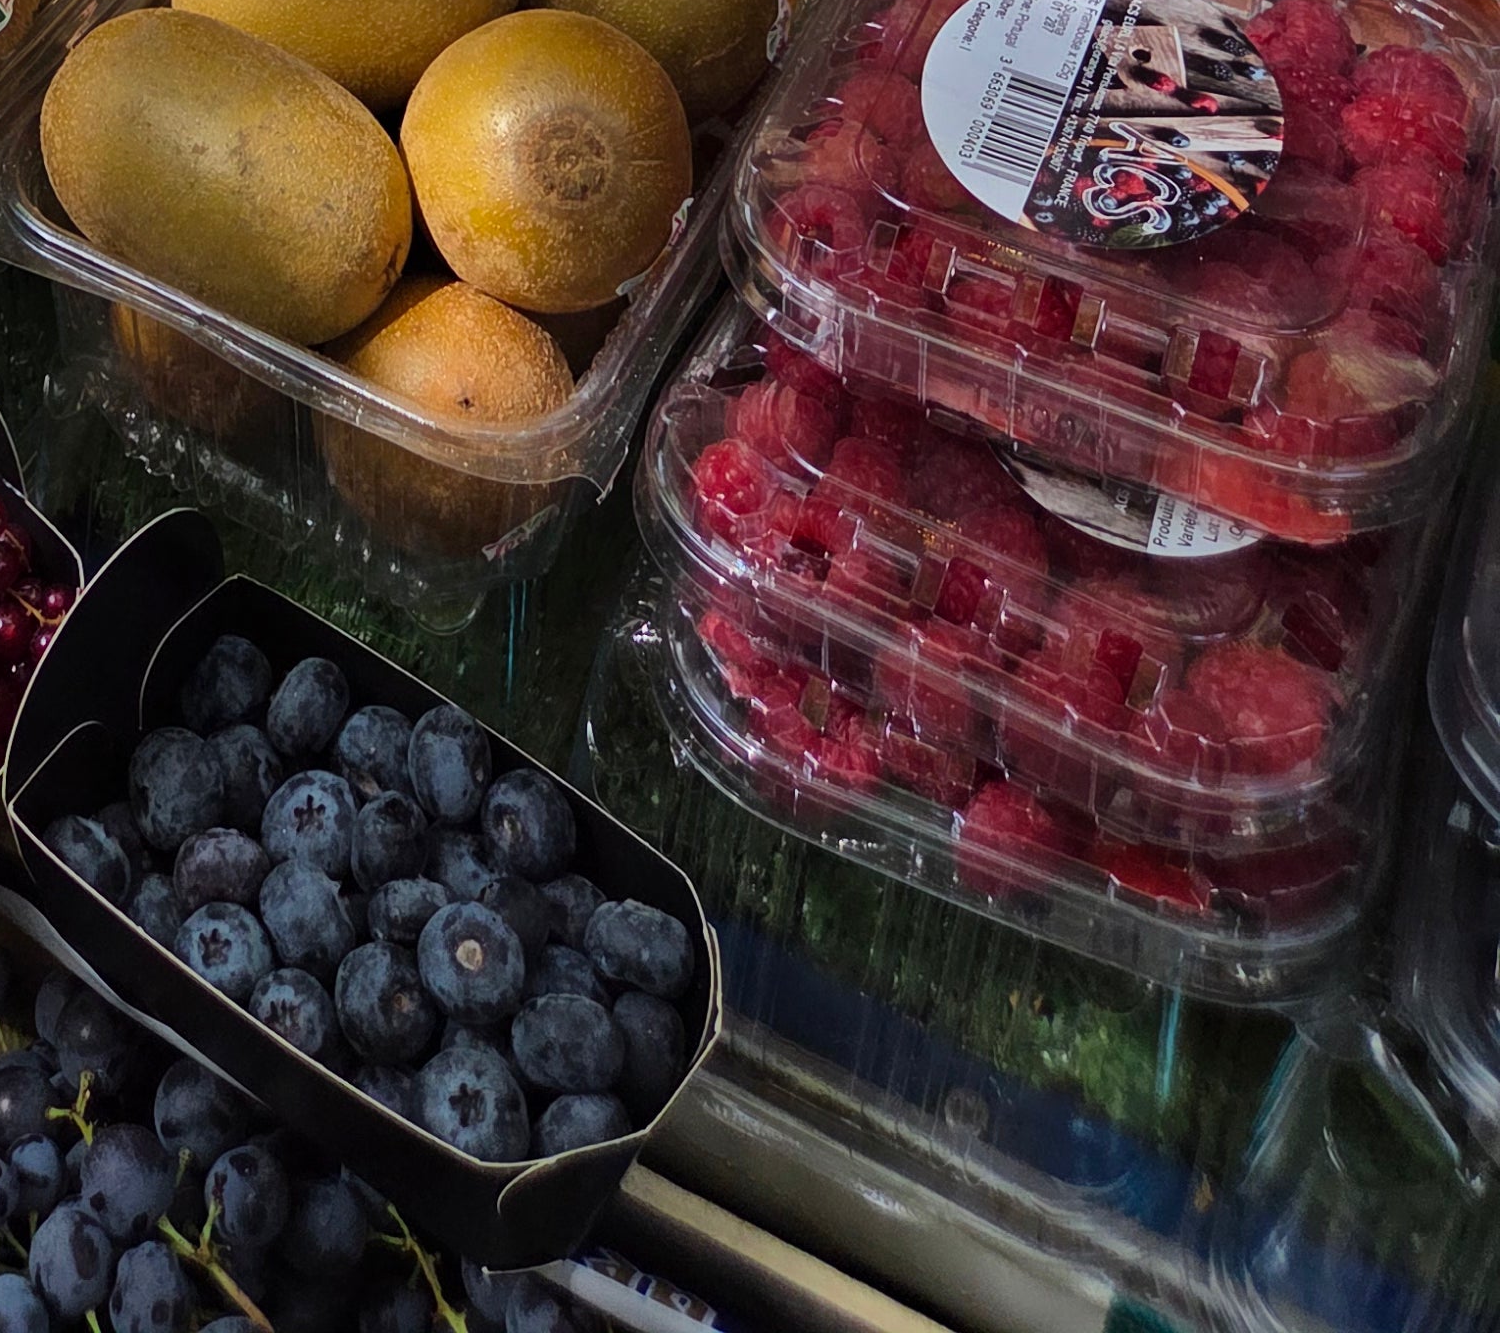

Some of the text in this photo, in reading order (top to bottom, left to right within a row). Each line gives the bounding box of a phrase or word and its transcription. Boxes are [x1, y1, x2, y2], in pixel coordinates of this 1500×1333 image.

[1004, 11, 1030, 49] Portugal
[1072, 6, 1099, 52] Framboise
[1055, 58, 1078, 81] 125g
[958, 54, 1014, 160] 3 663069 000403
[1054, 168, 1080, 209] FRANCE
[1081, 120, 1189, 232] ACS
[1113, 487, 1131, 516] ACS
